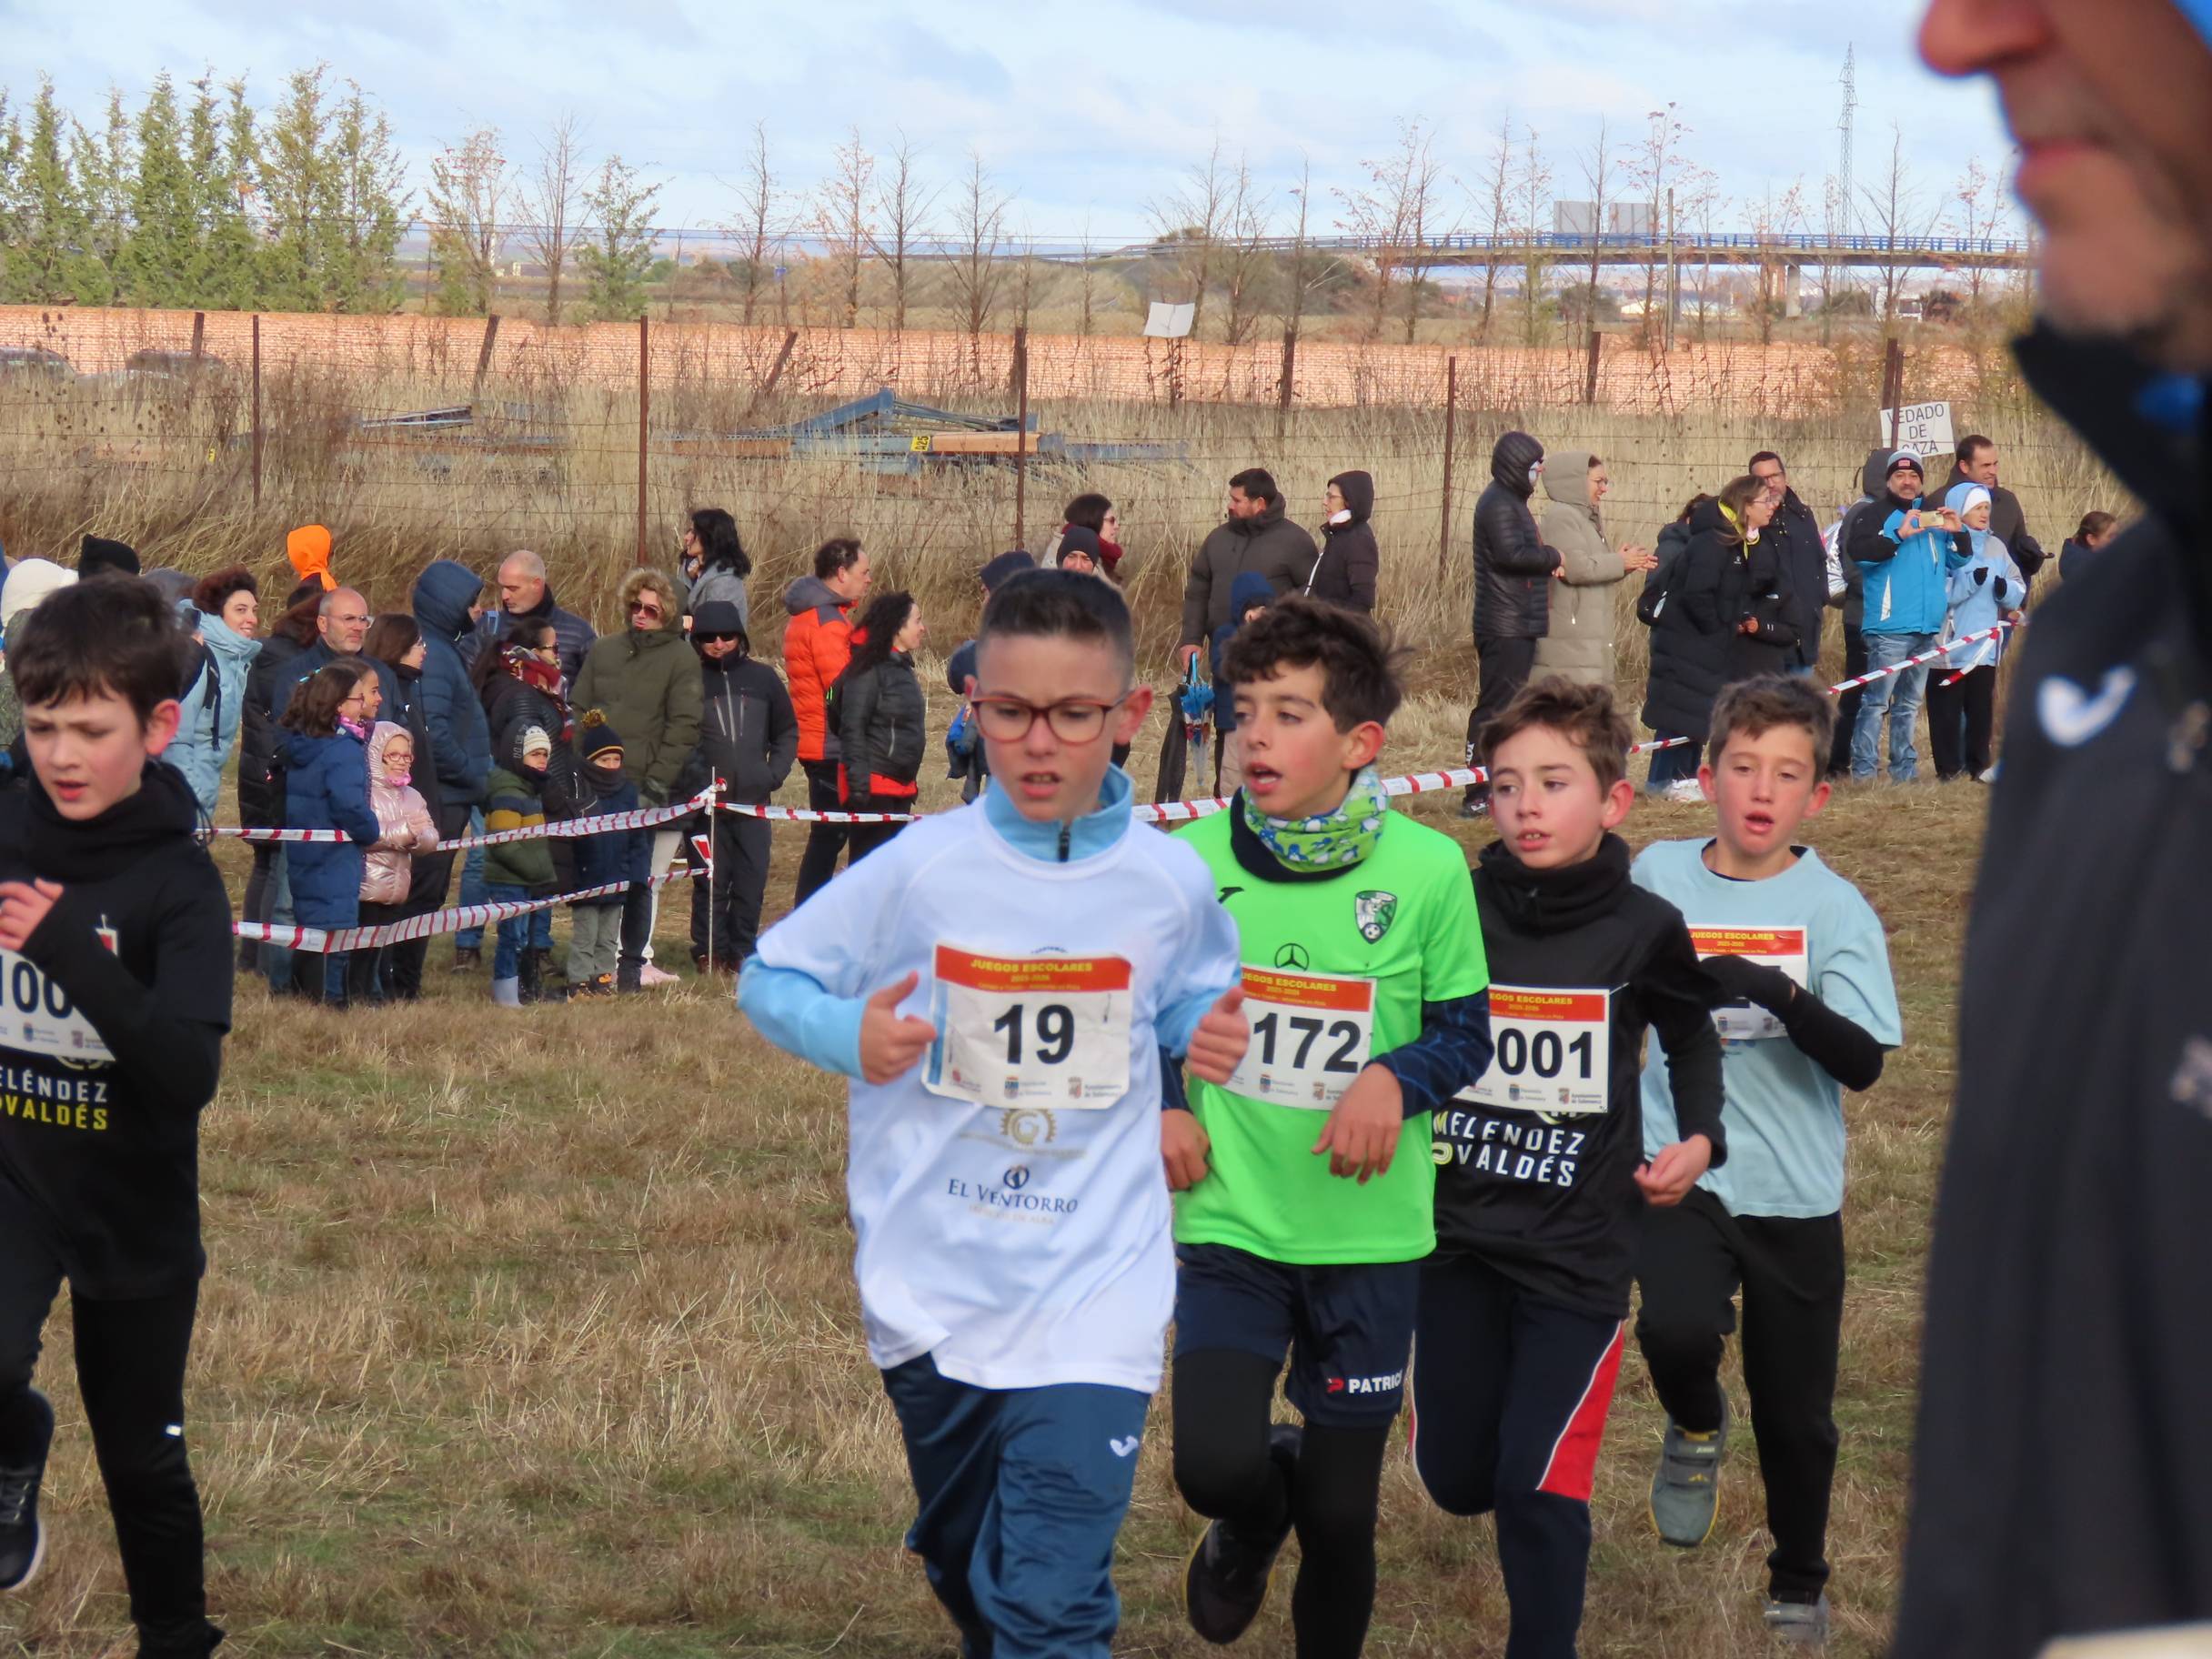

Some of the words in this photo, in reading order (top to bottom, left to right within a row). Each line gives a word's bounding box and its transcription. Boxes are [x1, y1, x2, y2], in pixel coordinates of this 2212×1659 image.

[1908, 424, 1927, 440] DE
[1690, 930, 1723, 940] JUEGOS
[1724, 931, 1775, 940] ESCOLARES
[970, 959, 1019, 973] JUEGOS
[1022, 961, 1093, 973] ESCOLARES
[1275, 978, 1337, 992] ESCOLARES
[1516, 995, 1574, 1005] ESCOLARES
[994, 1004, 1075, 1065] 19
[1253, 1011, 1362, 1073] 172
[1497, 1028, 1593, 1080] 001
[948, 1178, 970, 1198] EL
